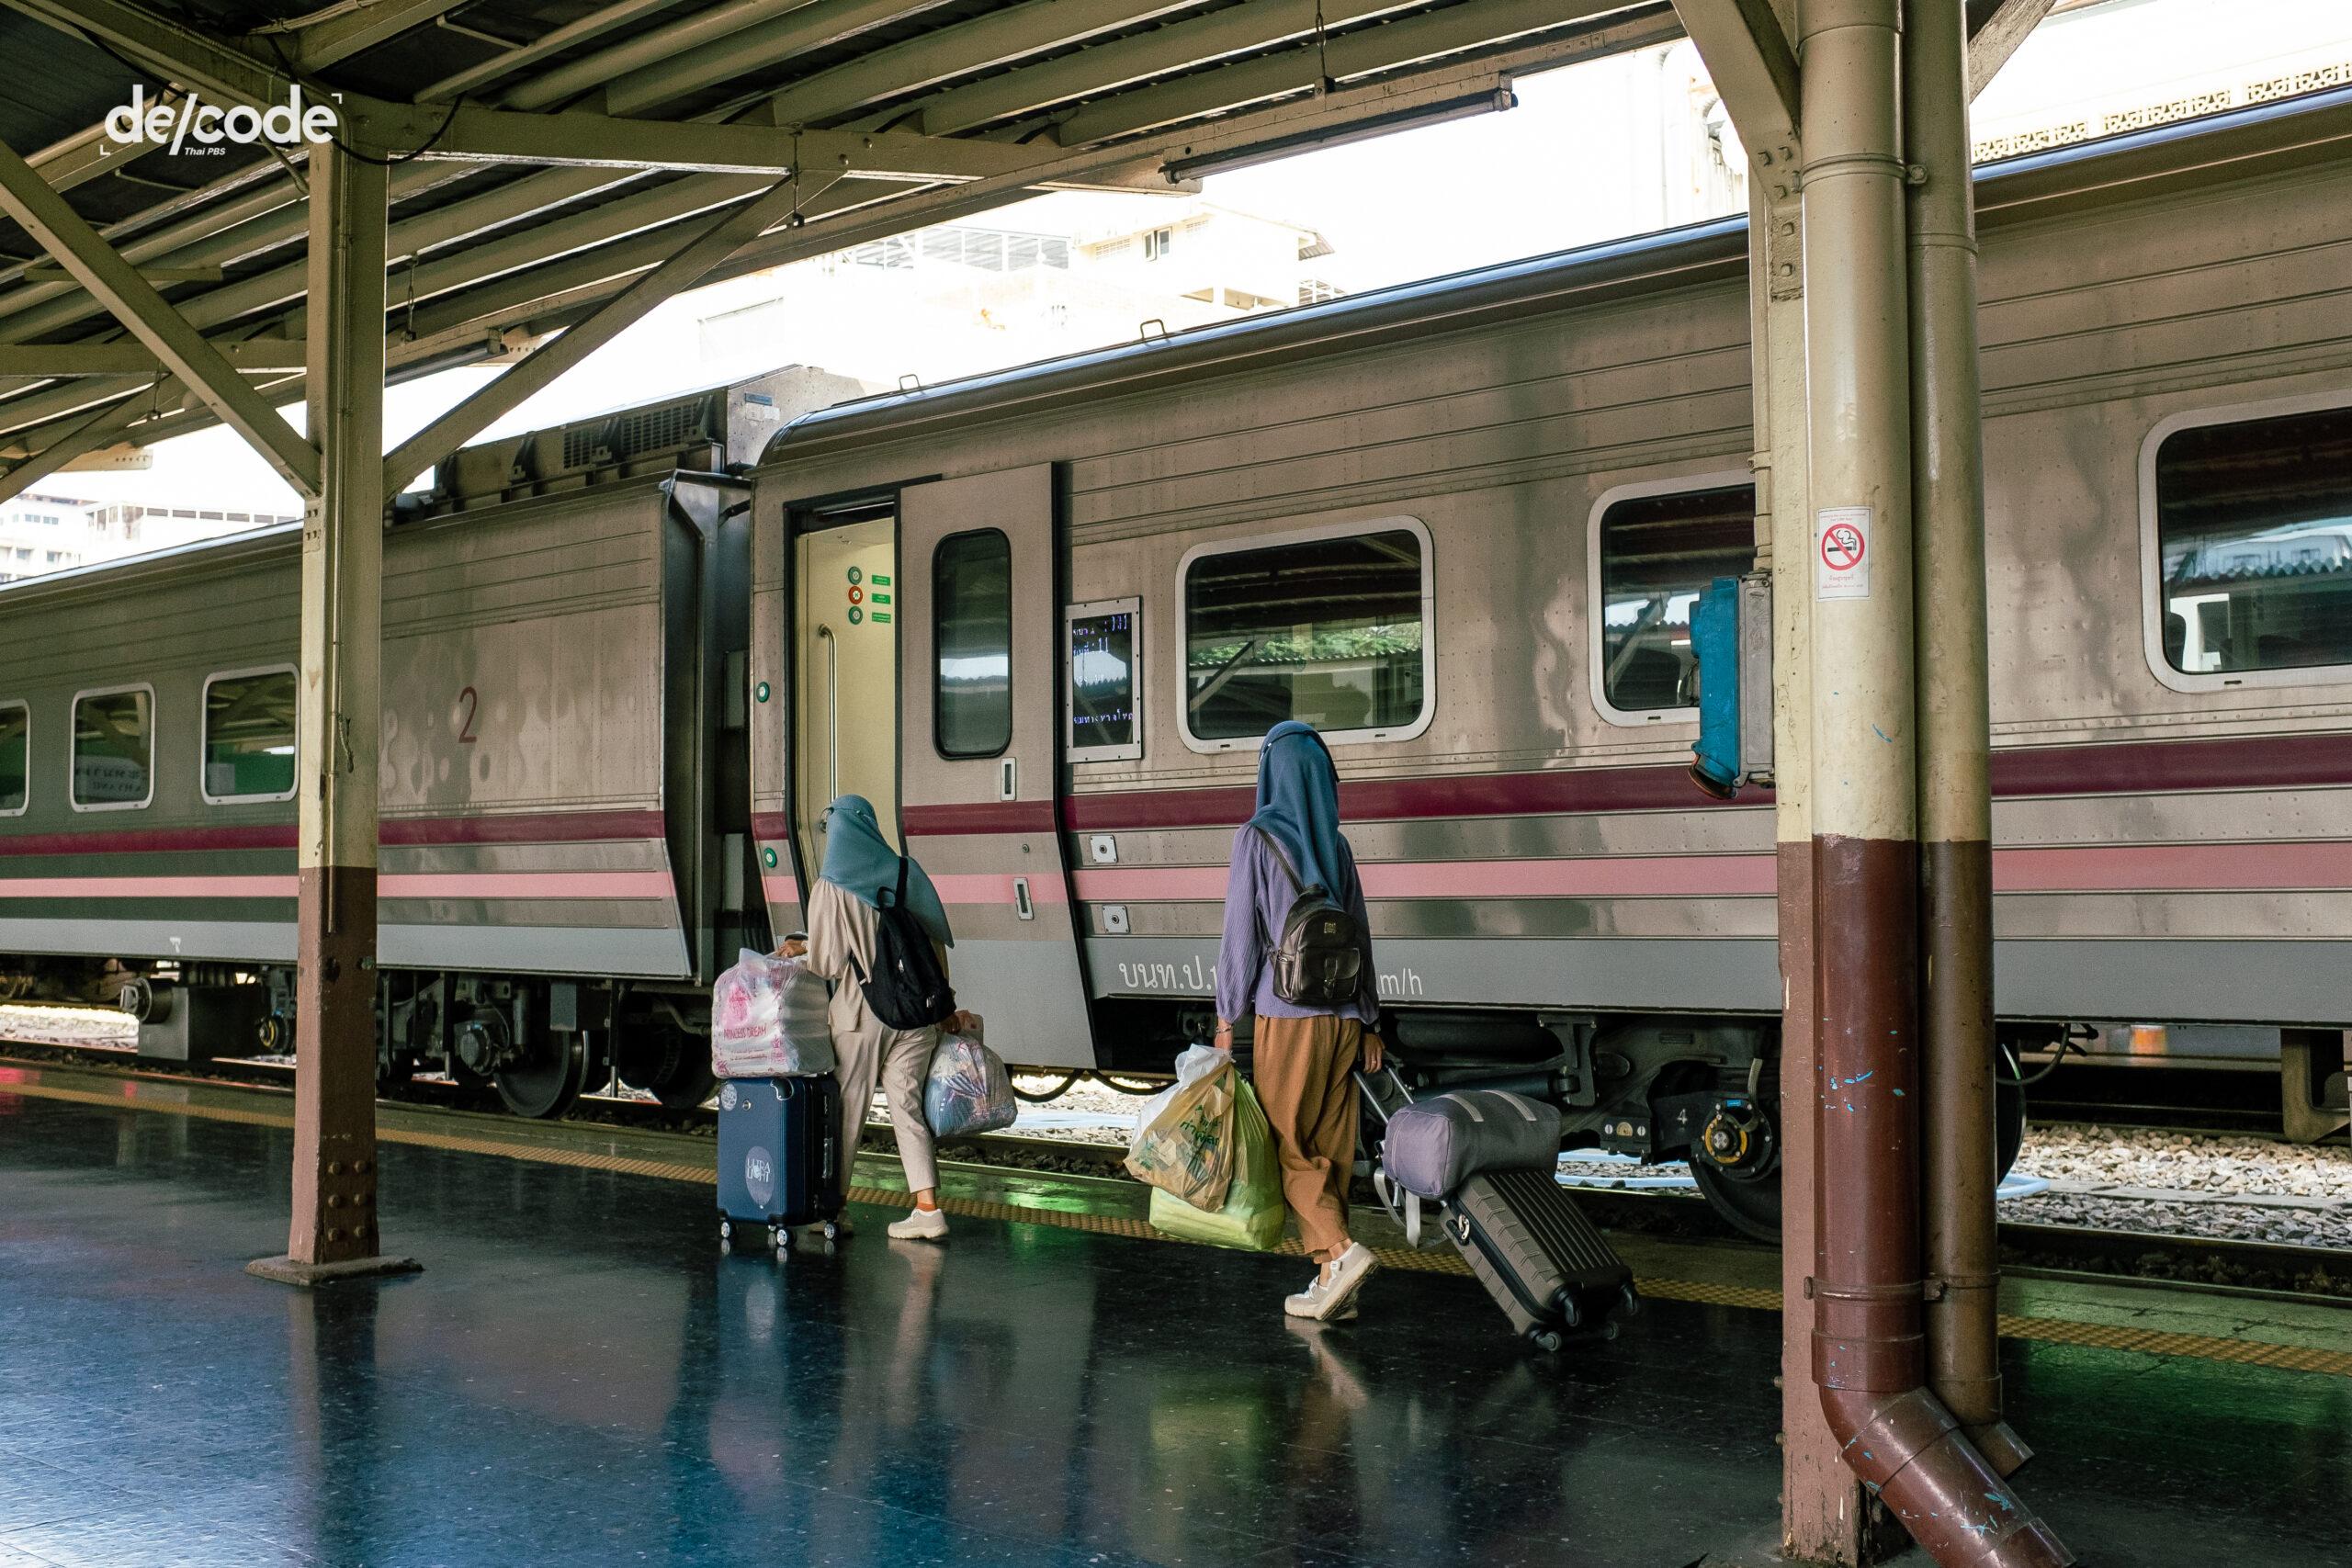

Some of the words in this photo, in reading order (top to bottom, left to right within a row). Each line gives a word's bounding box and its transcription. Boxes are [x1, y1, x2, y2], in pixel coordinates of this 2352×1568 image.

[458, 686, 478, 743] 2
[1119, 955, 1217, 990] บนท.ป.1
[1377, 967, 1423, 996] m/h
[1677, 1109, 1688, 1124] 4
[747, 1157, 771, 1173] ULTRA
